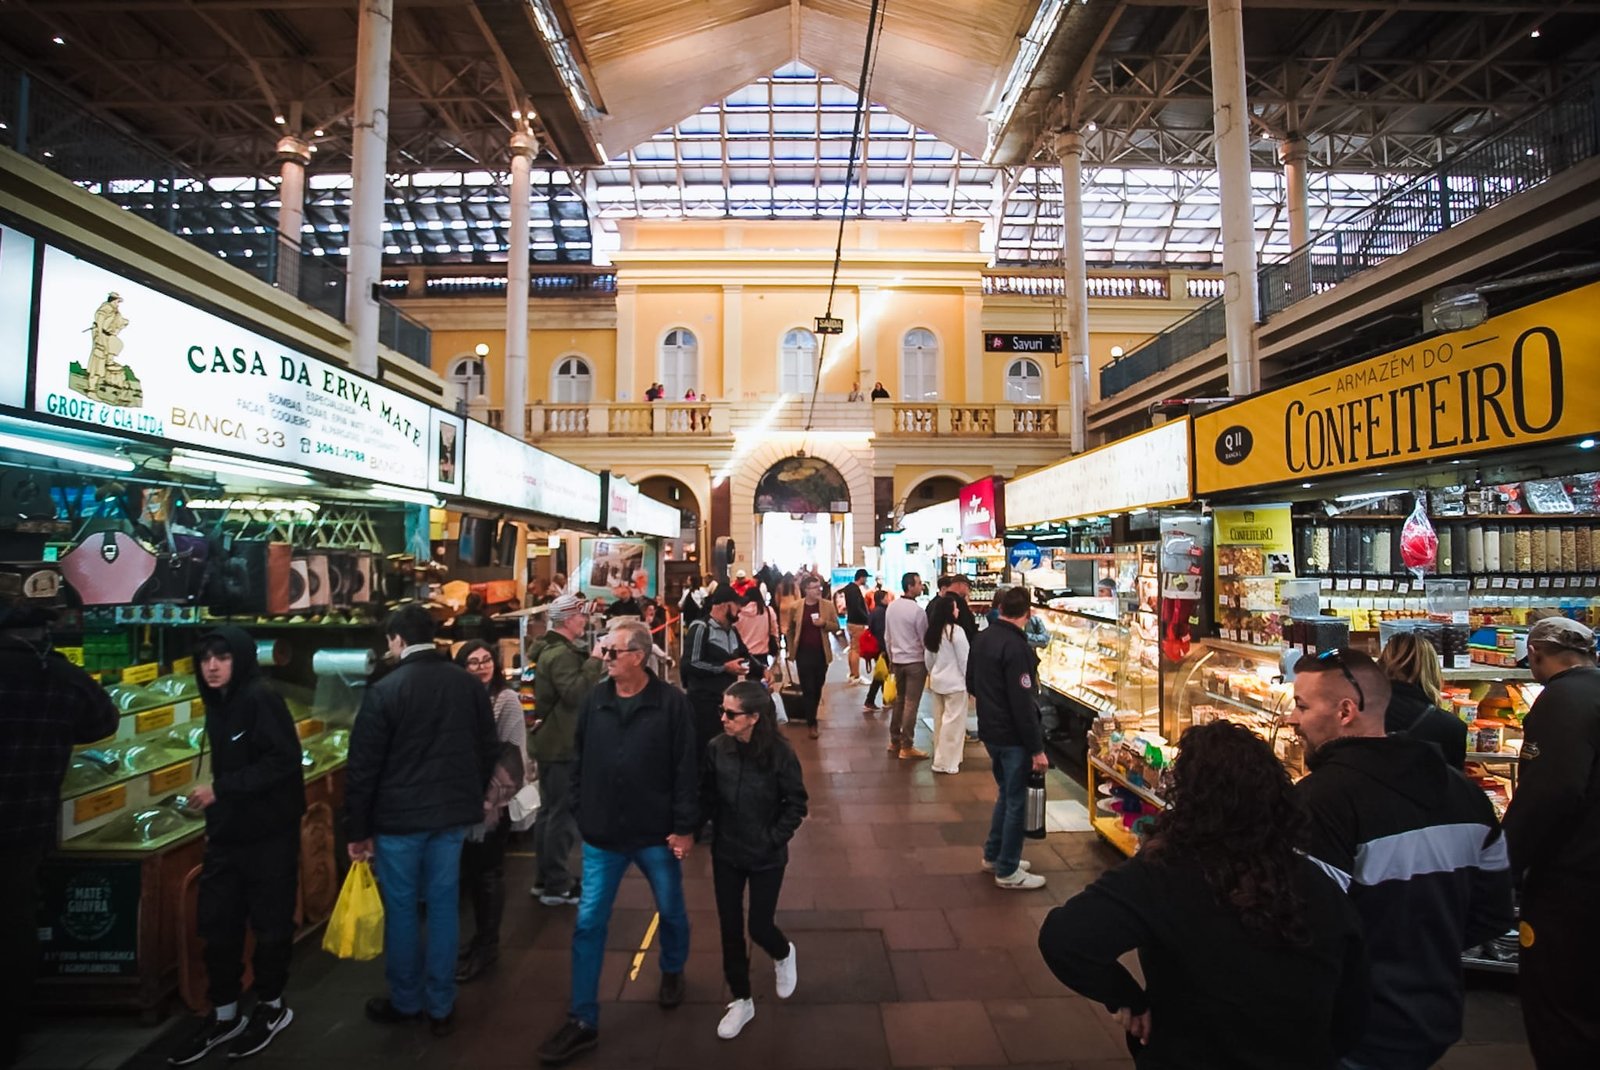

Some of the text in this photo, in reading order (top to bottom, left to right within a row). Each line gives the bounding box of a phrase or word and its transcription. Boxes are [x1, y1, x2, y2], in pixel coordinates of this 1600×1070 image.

[1012, 336, 1043, 350] Sayuri
[1336, 343, 1453, 394] ARMAZÉM DO
[47, 393, 95, 420] GROFF
[100, 406, 110, 423] &
[137, 414, 164, 436] LTDA
[187, 345, 268, 377] CASA
[281, 356, 312, 387] DA
[323, 370, 371, 411] ERVA
[380, 403, 422, 448] MATE
[1285, 326, 1564, 473] CONFEITEIRO
[171, 407, 286, 449] BANCA 33
[1230, 527, 1273, 541] CONFEITEIRO
[74, 887, 103, 900] MATE
